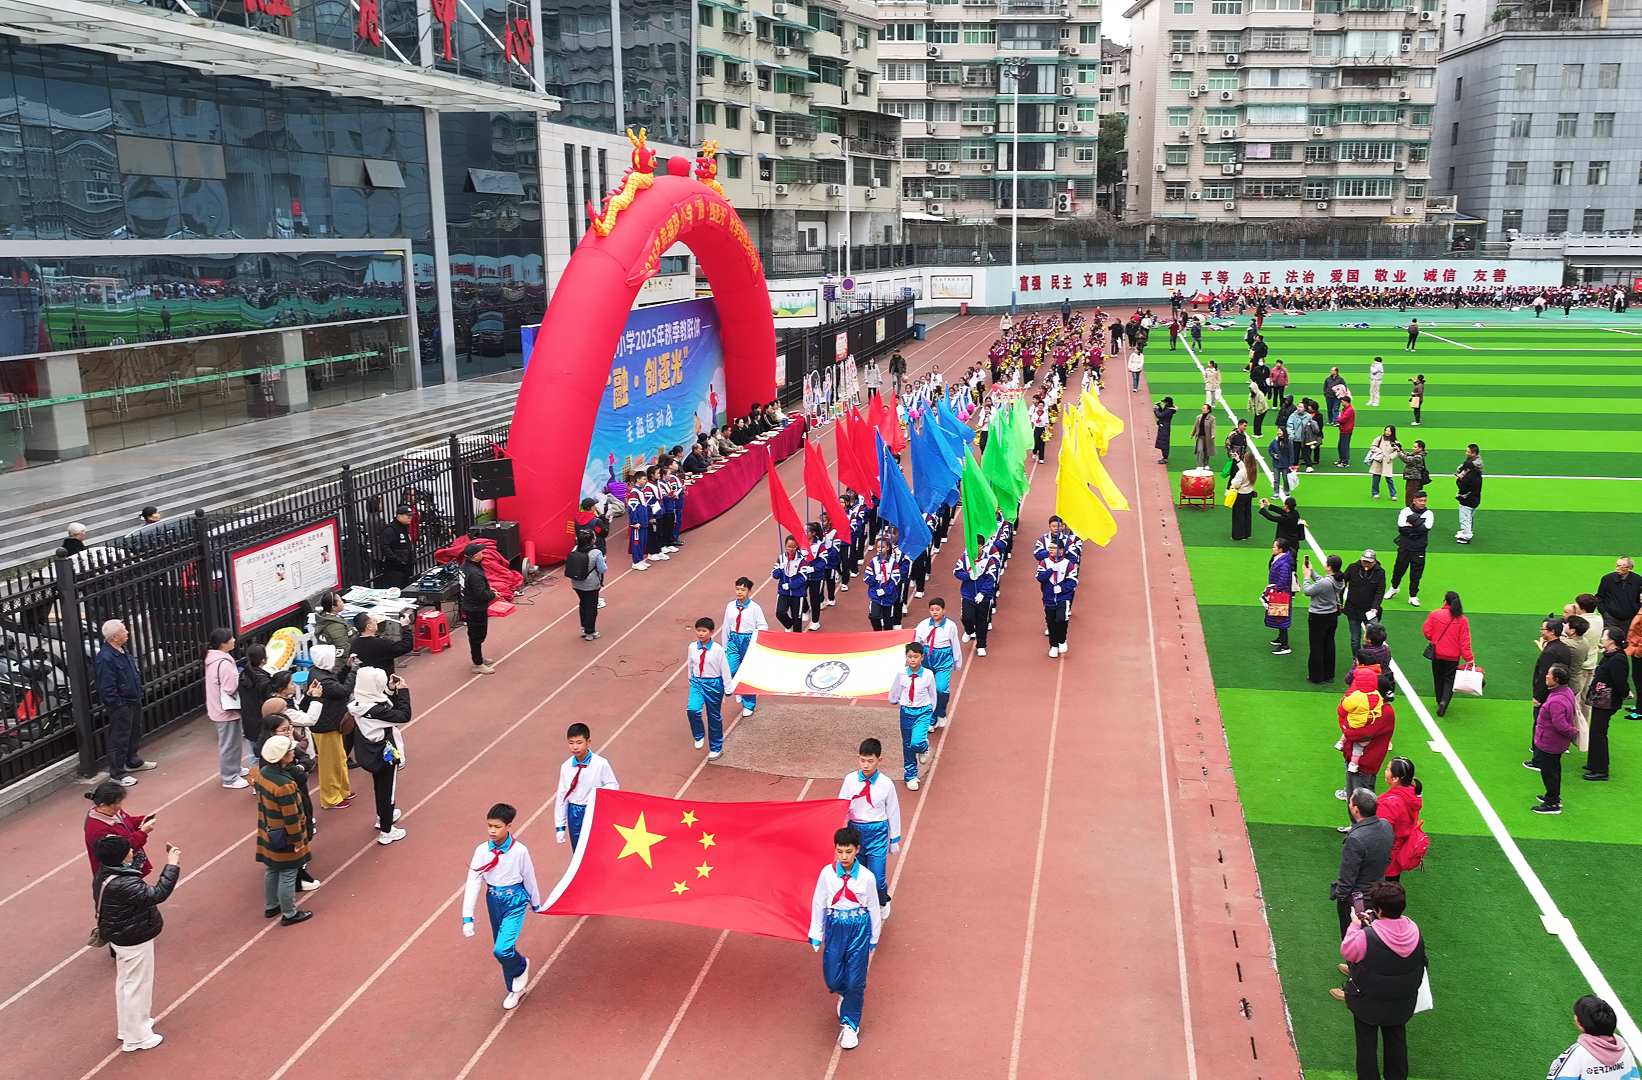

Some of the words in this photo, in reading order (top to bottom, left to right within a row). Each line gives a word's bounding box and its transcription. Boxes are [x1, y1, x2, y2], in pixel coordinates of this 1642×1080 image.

[1019, 275, 1042, 291] 富强
[1051, 274, 1072, 290] 民主
[1083, 272, 1107, 288] 文明
[1120, 272, 1149, 287] 和谐
[1162, 271, 1187, 286] 自由
[1200, 270, 1229, 285] 平等
[1242, 270, 1271, 285] 公正
[1285, 270, 1315, 284] 法治
[1330, 269, 1360, 283] 爱国
[1374, 269, 1407, 283] 敬业
[1423, 268, 1457, 283] 诚信
[1473, 268, 1507, 283] 友善
[625, 404, 673, 443] 主题运动会
